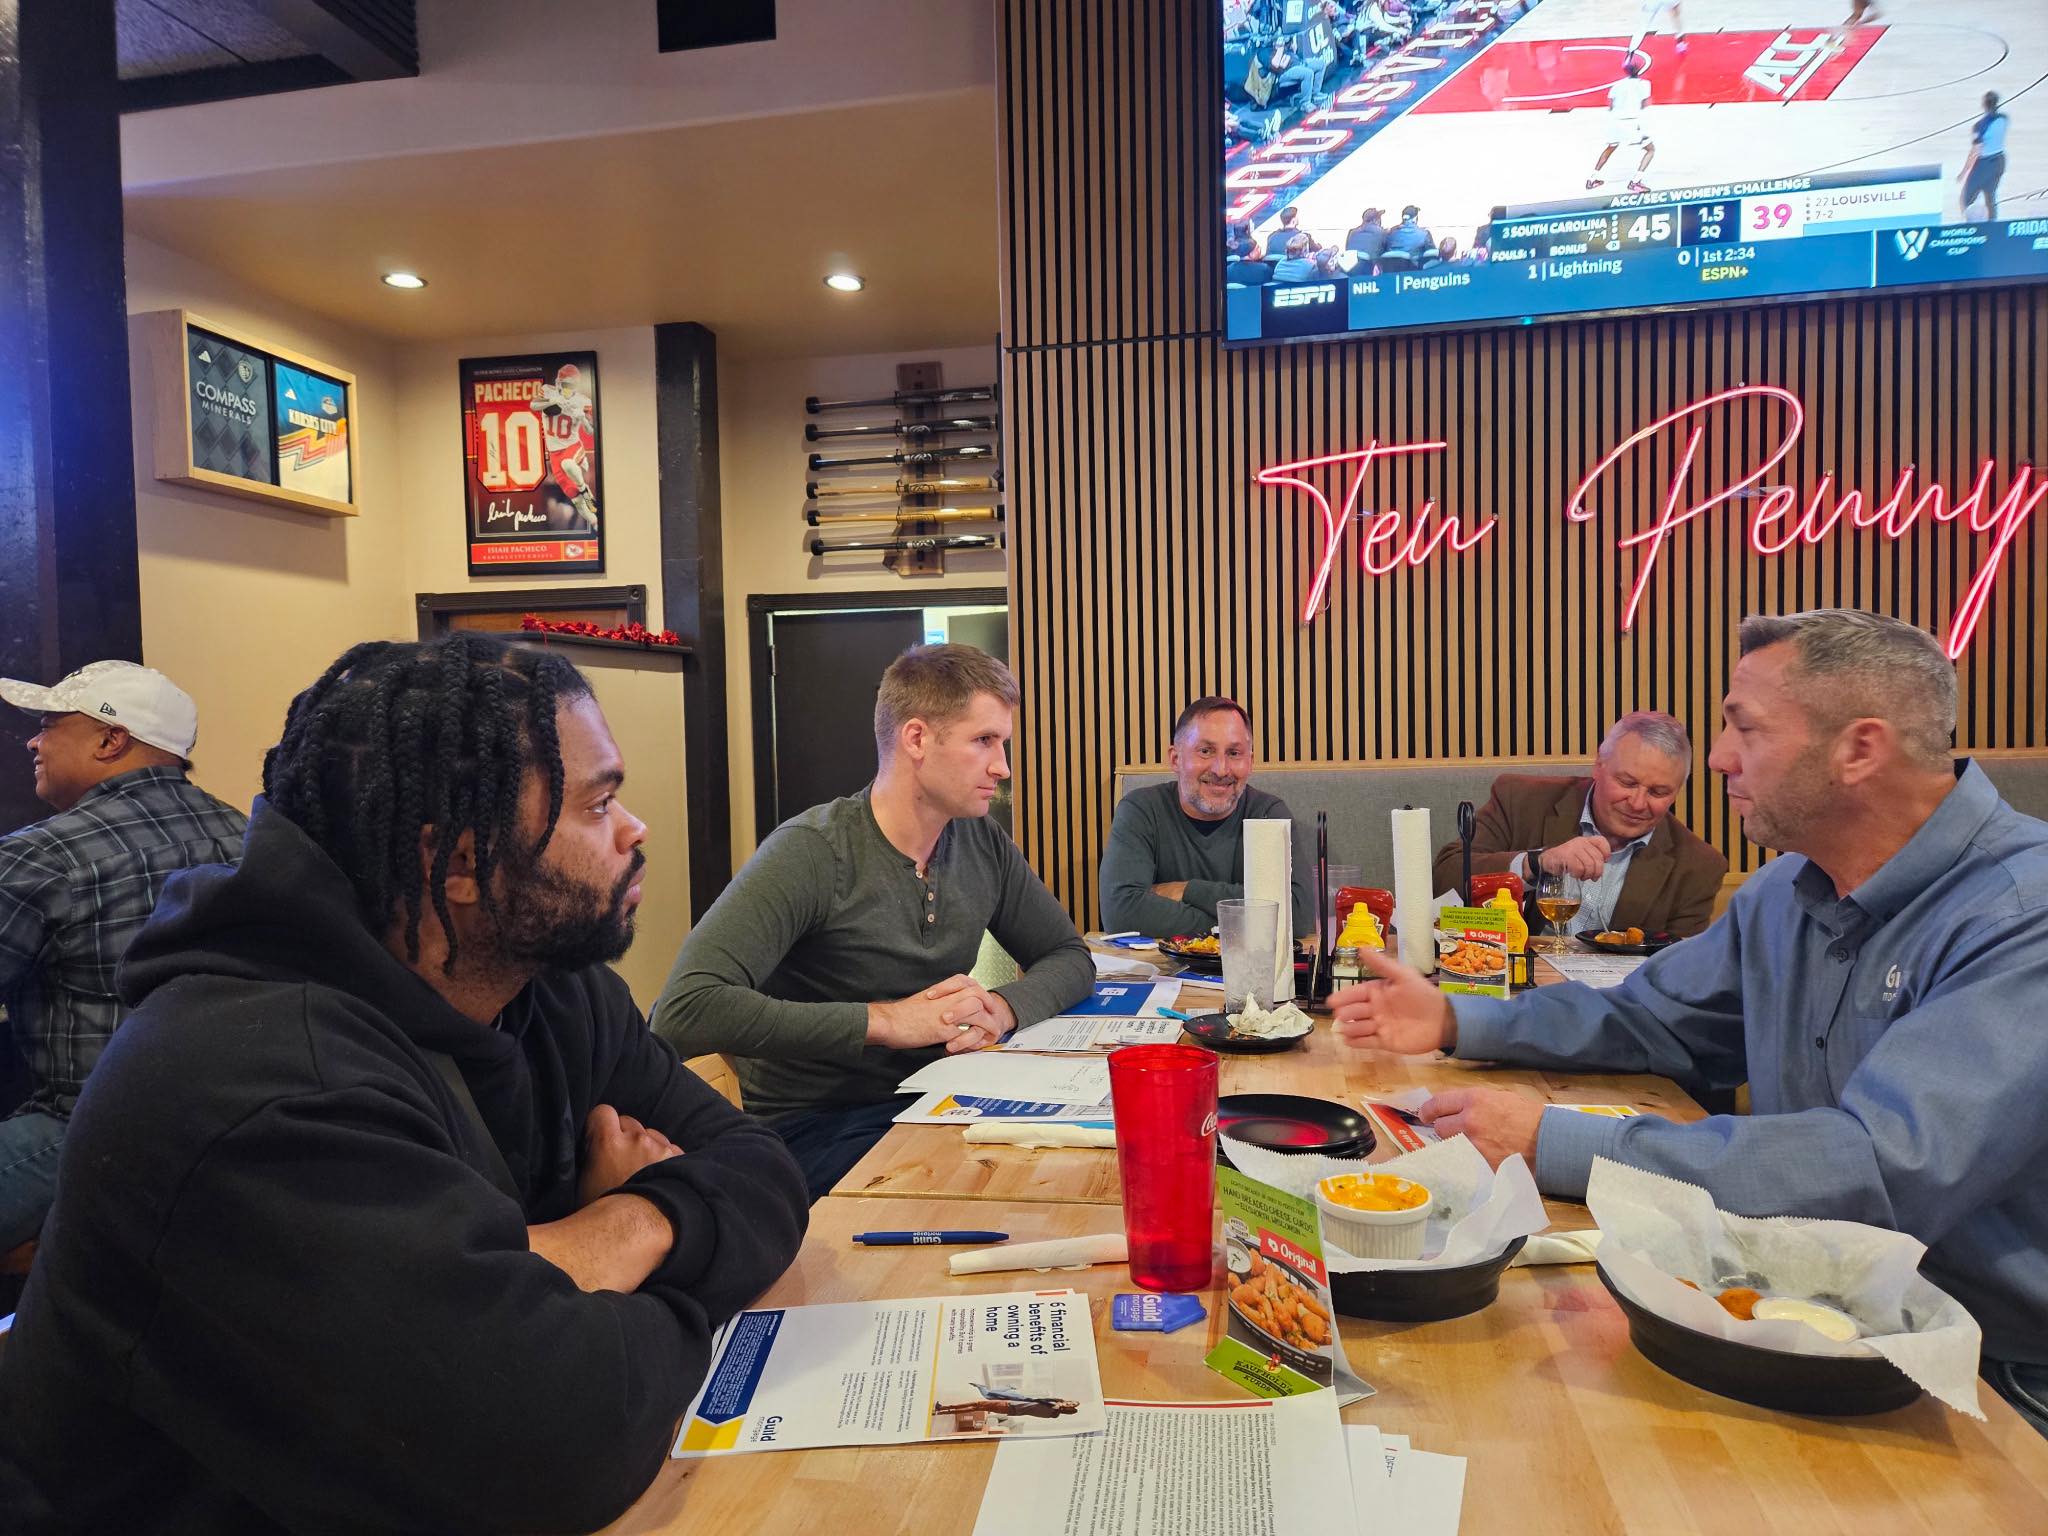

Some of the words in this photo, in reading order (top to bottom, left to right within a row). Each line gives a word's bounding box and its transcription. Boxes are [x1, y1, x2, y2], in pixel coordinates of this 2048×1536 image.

[1743, 31, 1832, 94] ACC
[1610, 190, 1667, 208] ACC/SEC
[1669, 184, 1731, 202] WOMEN'S
[1733, 178, 1811, 196] CHALLENGE
[1832, 190, 1907, 206] LOUISVILLE
[1698, 205, 1725, 222] 1.5
[1752, 203, 1793, 230] 39
[1815, 210, 1834, 219] 7-2
[1509, 224, 1548, 238] SOUTH
[1548, 217, 1607, 234] CAROLINA
[1588, 231, 1607, 241] 7-1
[1627, 213, 1671, 242] 45
[1700, 224, 1721, 239] 2Q
[1940, 227, 1977, 237] WORLD
[2007, 219, 2048, 237] FRIDA
[1529, 248, 1536, 258] 1
[1550, 243, 1588, 256] BONUS
[1929, 236, 1988, 248] CHAMPIONS
[1946, 246, 1969, 256] CUP
[1677, 251, 1690, 266] 0
[1702, 248, 1723, 263] 1st
[1724, 247, 1755, 261] 2:34
[1528, 264, 1537, 279] 1
[1550, 258, 1623, 279] Lightning
[1701, 265, 1749, 282] ESPN+
[1353, 281, 1380, 295] NHL
[1403, 272, 1470, 291] Penguins
[1274, 284, 1336, 308] ESPN
[196, 381, 256, 415] COMPASS
[474, 381, 542, 403] PACHECO
[201, 401, 251, 425] MINERALS
[547, 415, 573, 439] 10
[480, 411, 545, 487] 10
[1256, 439, 1497, 624] Ten
[1567, 384, 2048, 659] Penny
[487, 546, 509, 554] ISIAH
[510, 545, 548, 553] PACHECO
[1477, 931, 1501, 940] Original
[1223, 1186, 1241, 1199] HAND
[1268, 1206, 1291, 1222] CHEESE
[1292, 1216, 1314, 1234] CURDS
[912, 1236, 942, 1244] Guild
[1280, 1242, 1317, 1275] Original
[985, 1306, 1002, 1332] home
[1130, 1294, 1142, 1322] mortgage
[1142, 1294, 1163, 1322] Guild
[1003, 1304, 1024, 1340] owning
[1028, 1303, 1047, 1342] benefits
[1051, 1309, 1071, 1352] financial
[1030, 1344, 1048, 1355] of
[1235, 1360, 1294, 1394] KAUFHOLD'S
[1243, 1375, 1272, 1392] KURDS
[750, 1416, 765, 1443] mortgage
[760, 1416, 783, 1442] Guild
